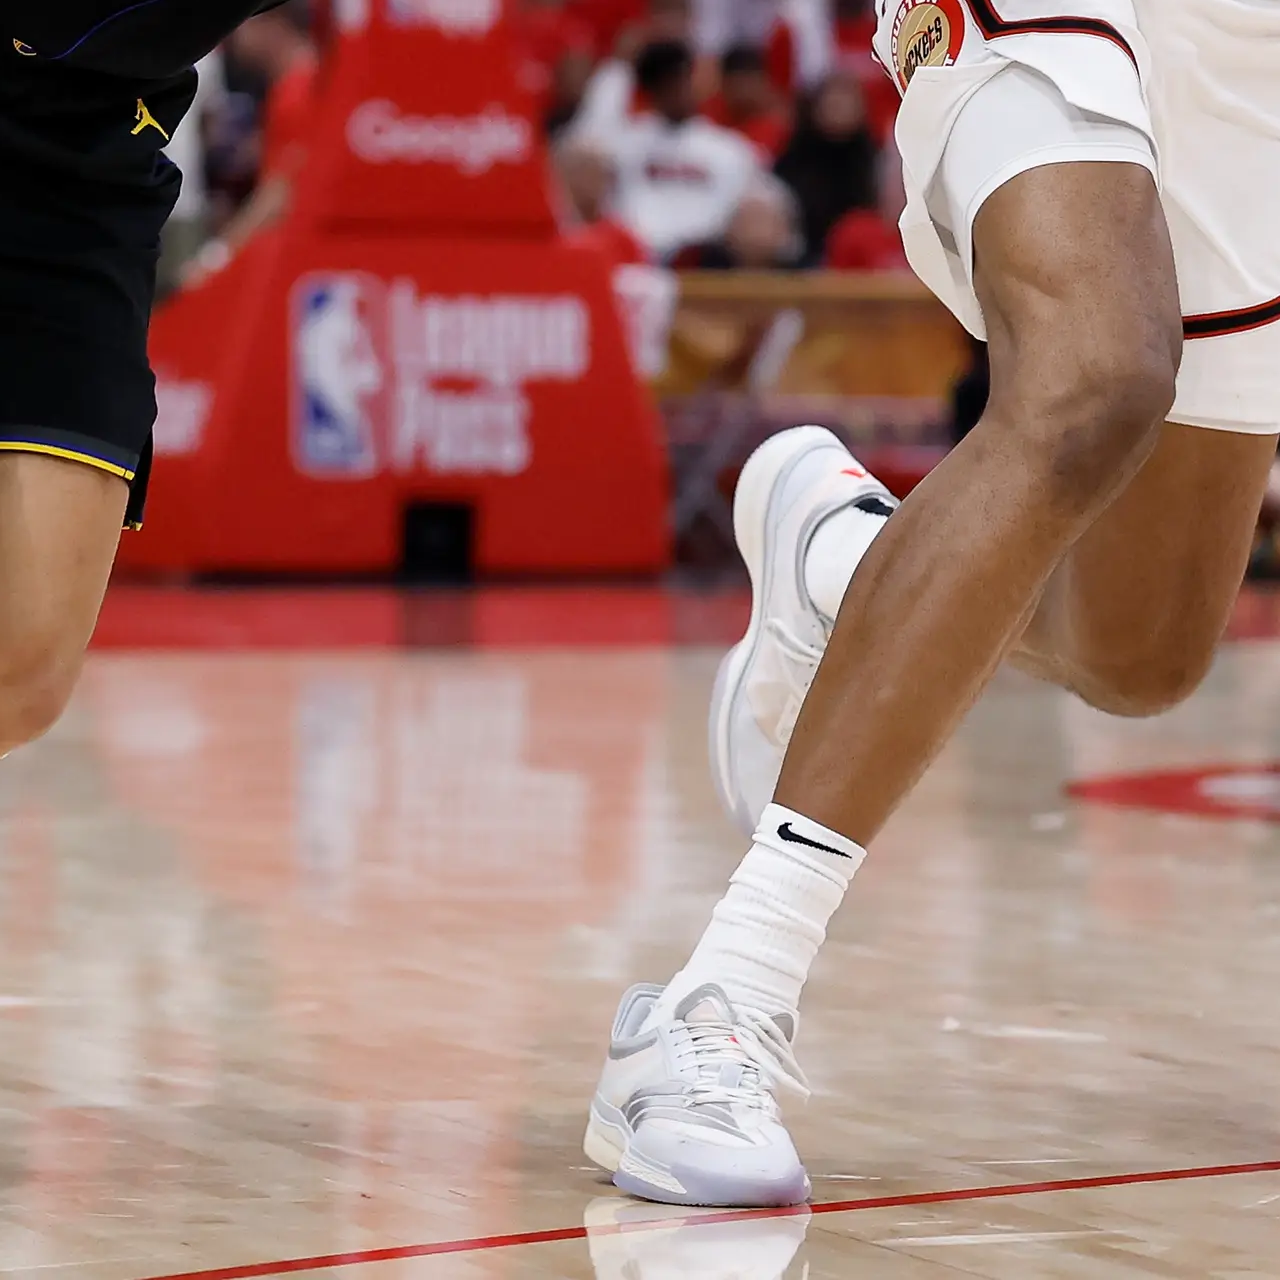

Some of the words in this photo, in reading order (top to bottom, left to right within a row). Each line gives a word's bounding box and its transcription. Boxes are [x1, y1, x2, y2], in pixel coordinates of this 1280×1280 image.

[345, 98, 533, 176] Google
[389, 276, 590, 383] League
[389, 382, 533, 476] Pass
